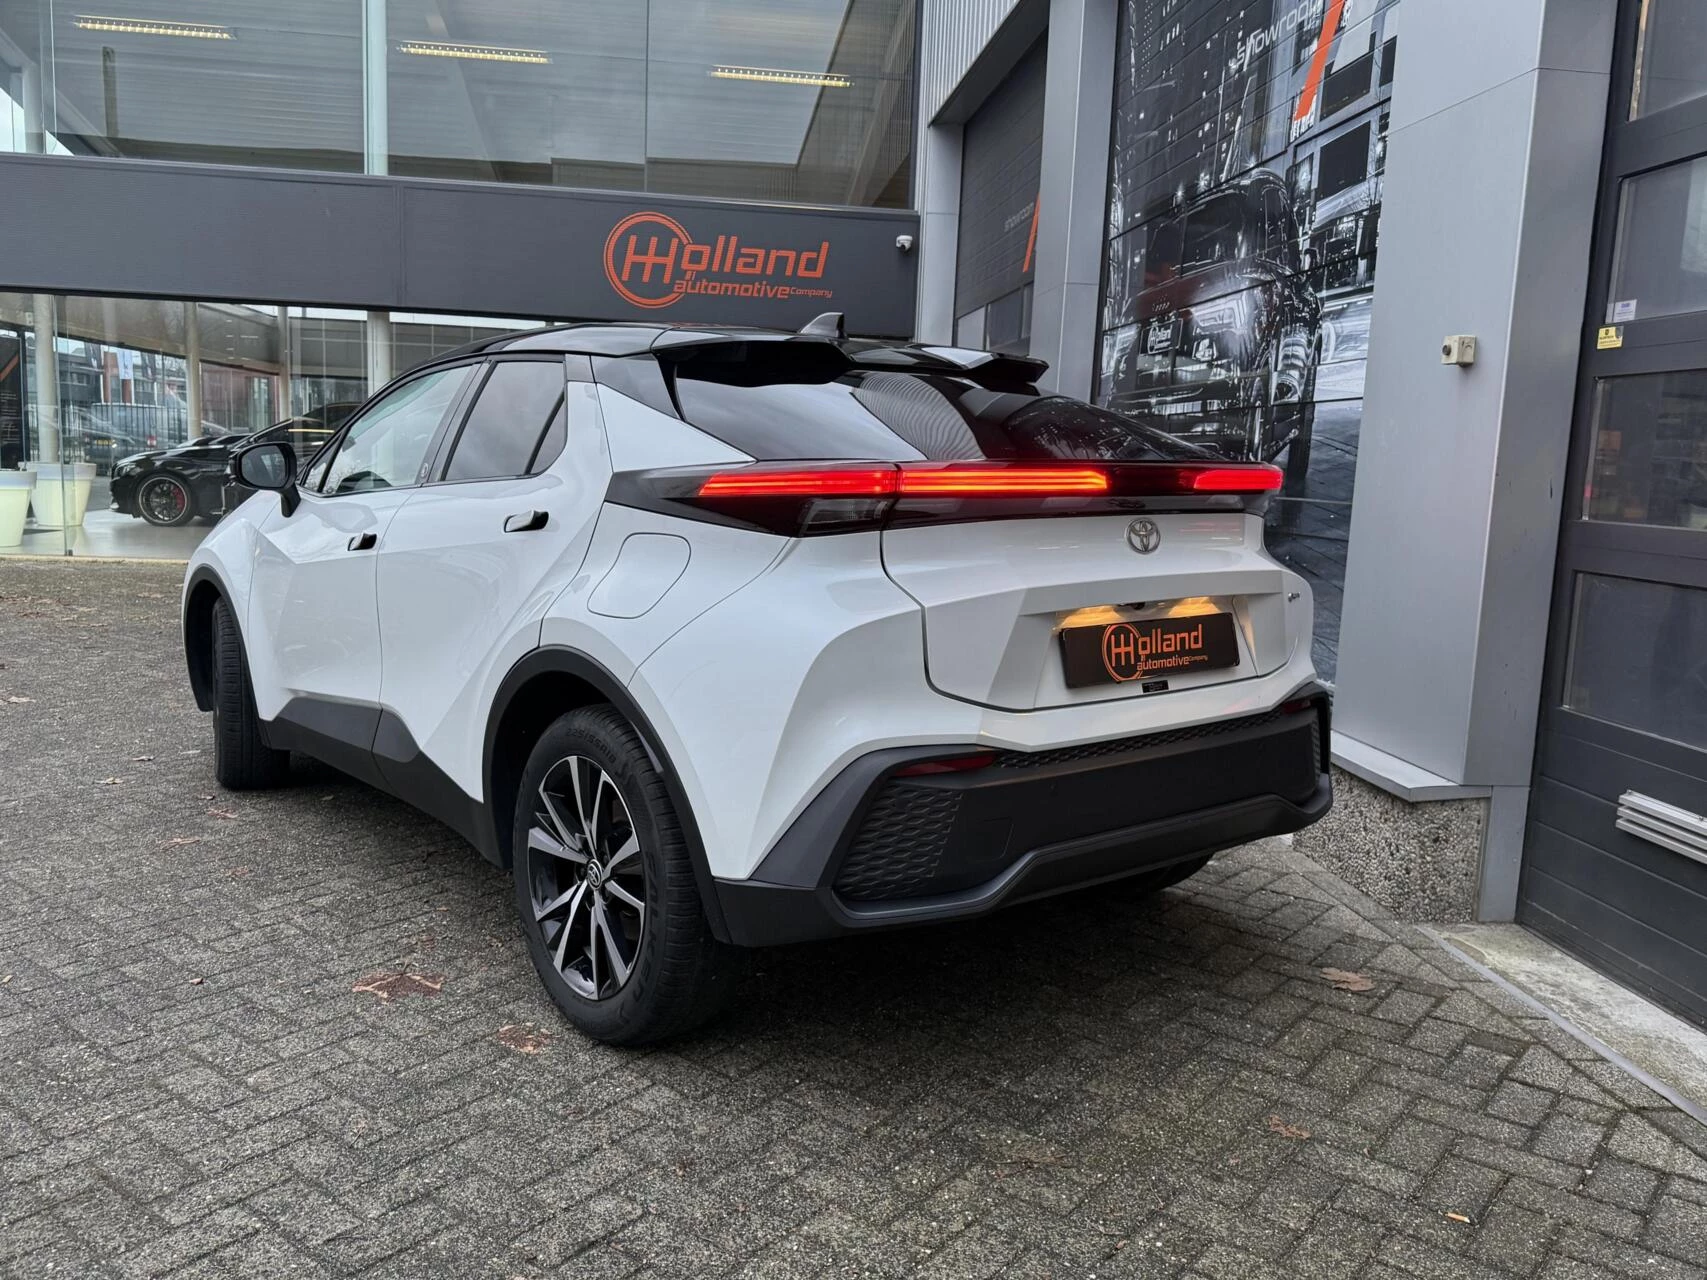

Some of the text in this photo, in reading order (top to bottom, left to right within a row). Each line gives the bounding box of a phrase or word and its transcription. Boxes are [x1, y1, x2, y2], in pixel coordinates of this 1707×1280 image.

[621, 235, 829, 284] Holland
[673, 279, 833, 299] automotive Company
[1111, 623, 1203, 667] Holland
[1136, 654, 1189, 671] automotive
